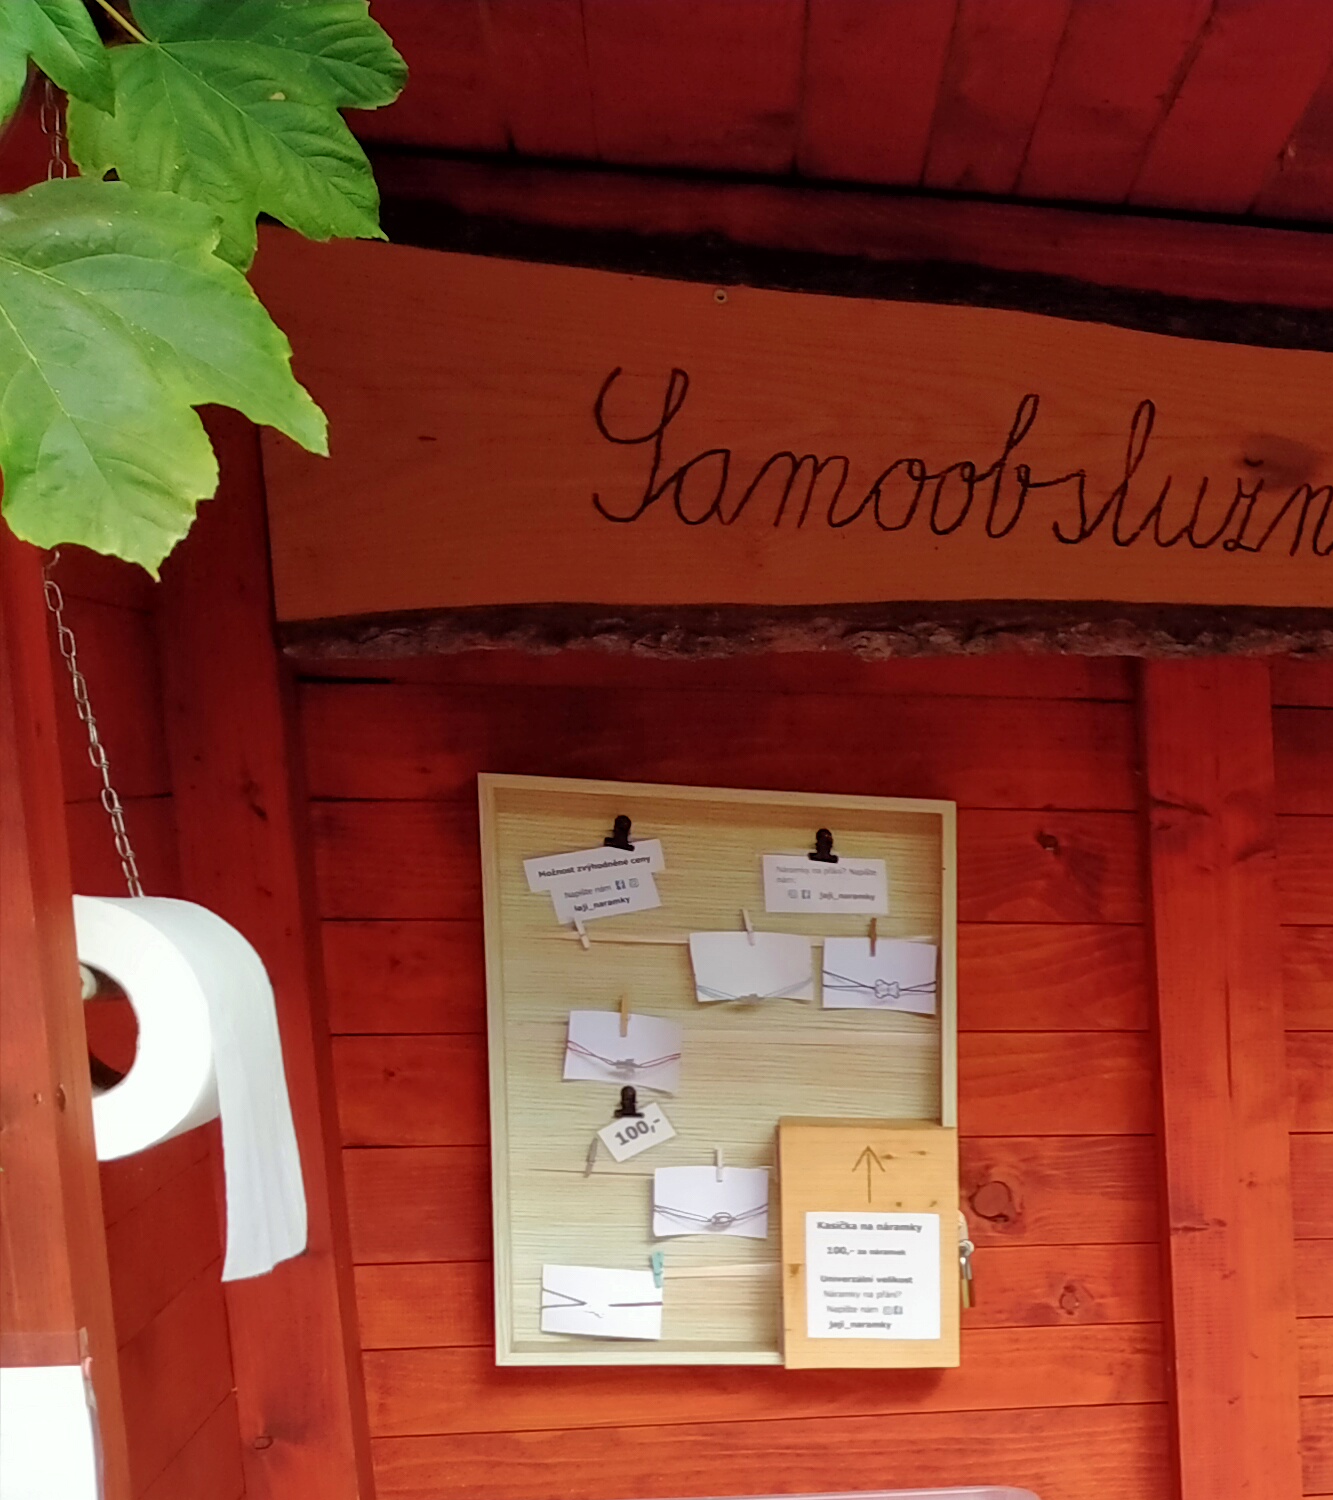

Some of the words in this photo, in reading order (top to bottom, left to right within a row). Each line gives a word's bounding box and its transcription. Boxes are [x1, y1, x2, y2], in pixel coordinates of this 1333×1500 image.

[538, 867, 575, 878] Možnost
[630, 856, 651, 864] ceny
[615, 1119, 660, 1146] 100,-
